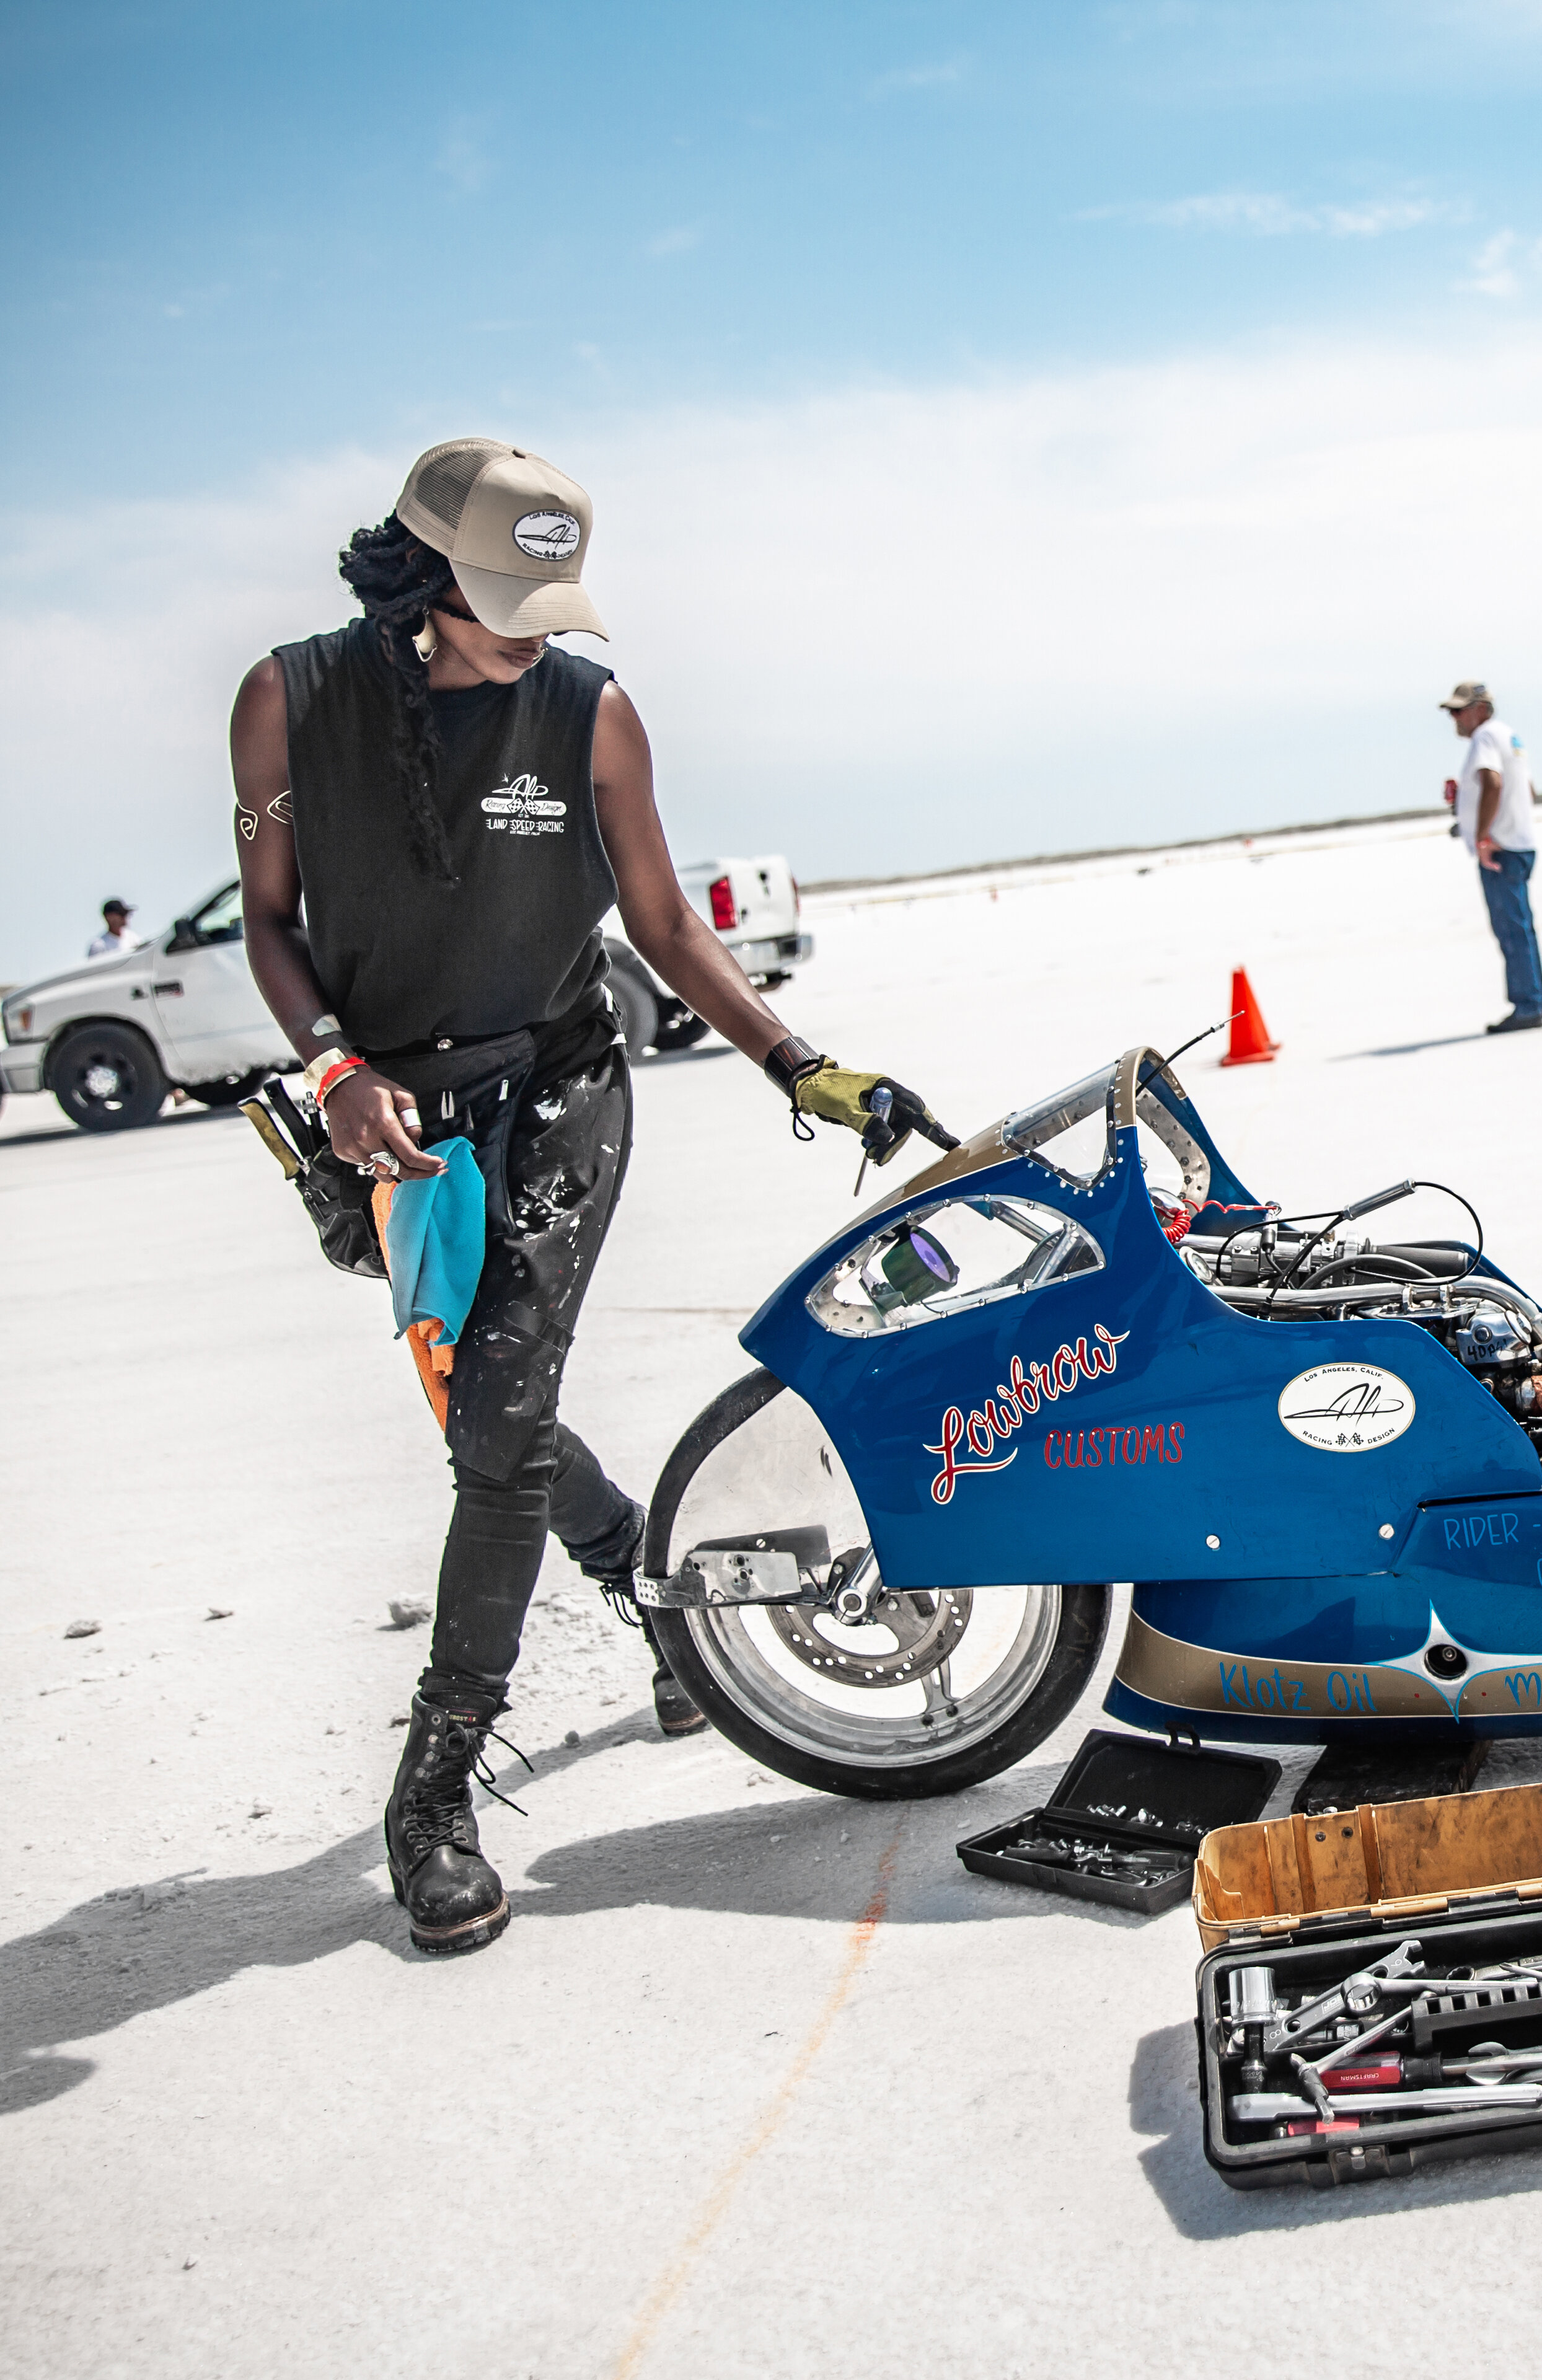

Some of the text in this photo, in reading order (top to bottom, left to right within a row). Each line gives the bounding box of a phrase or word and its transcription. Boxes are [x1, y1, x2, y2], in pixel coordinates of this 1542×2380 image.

[486, 819, 565, 833] LAND SPEED RACING
[1304, 1373, 1318, 1382] LOS
[923, 1323, 1130, 1505] Lowbrow
[1044, 1422, 1185, 1470] CUSTOMS
[1302, 1427, 1396, 1445] RACING DESIGN
[1443, 1512, 1519, 1550] RIDER
[1218, 1661, 1378, 1712] Klotz Oil
[1341, 2072, 1380, 2081] CRAFTSMAN
